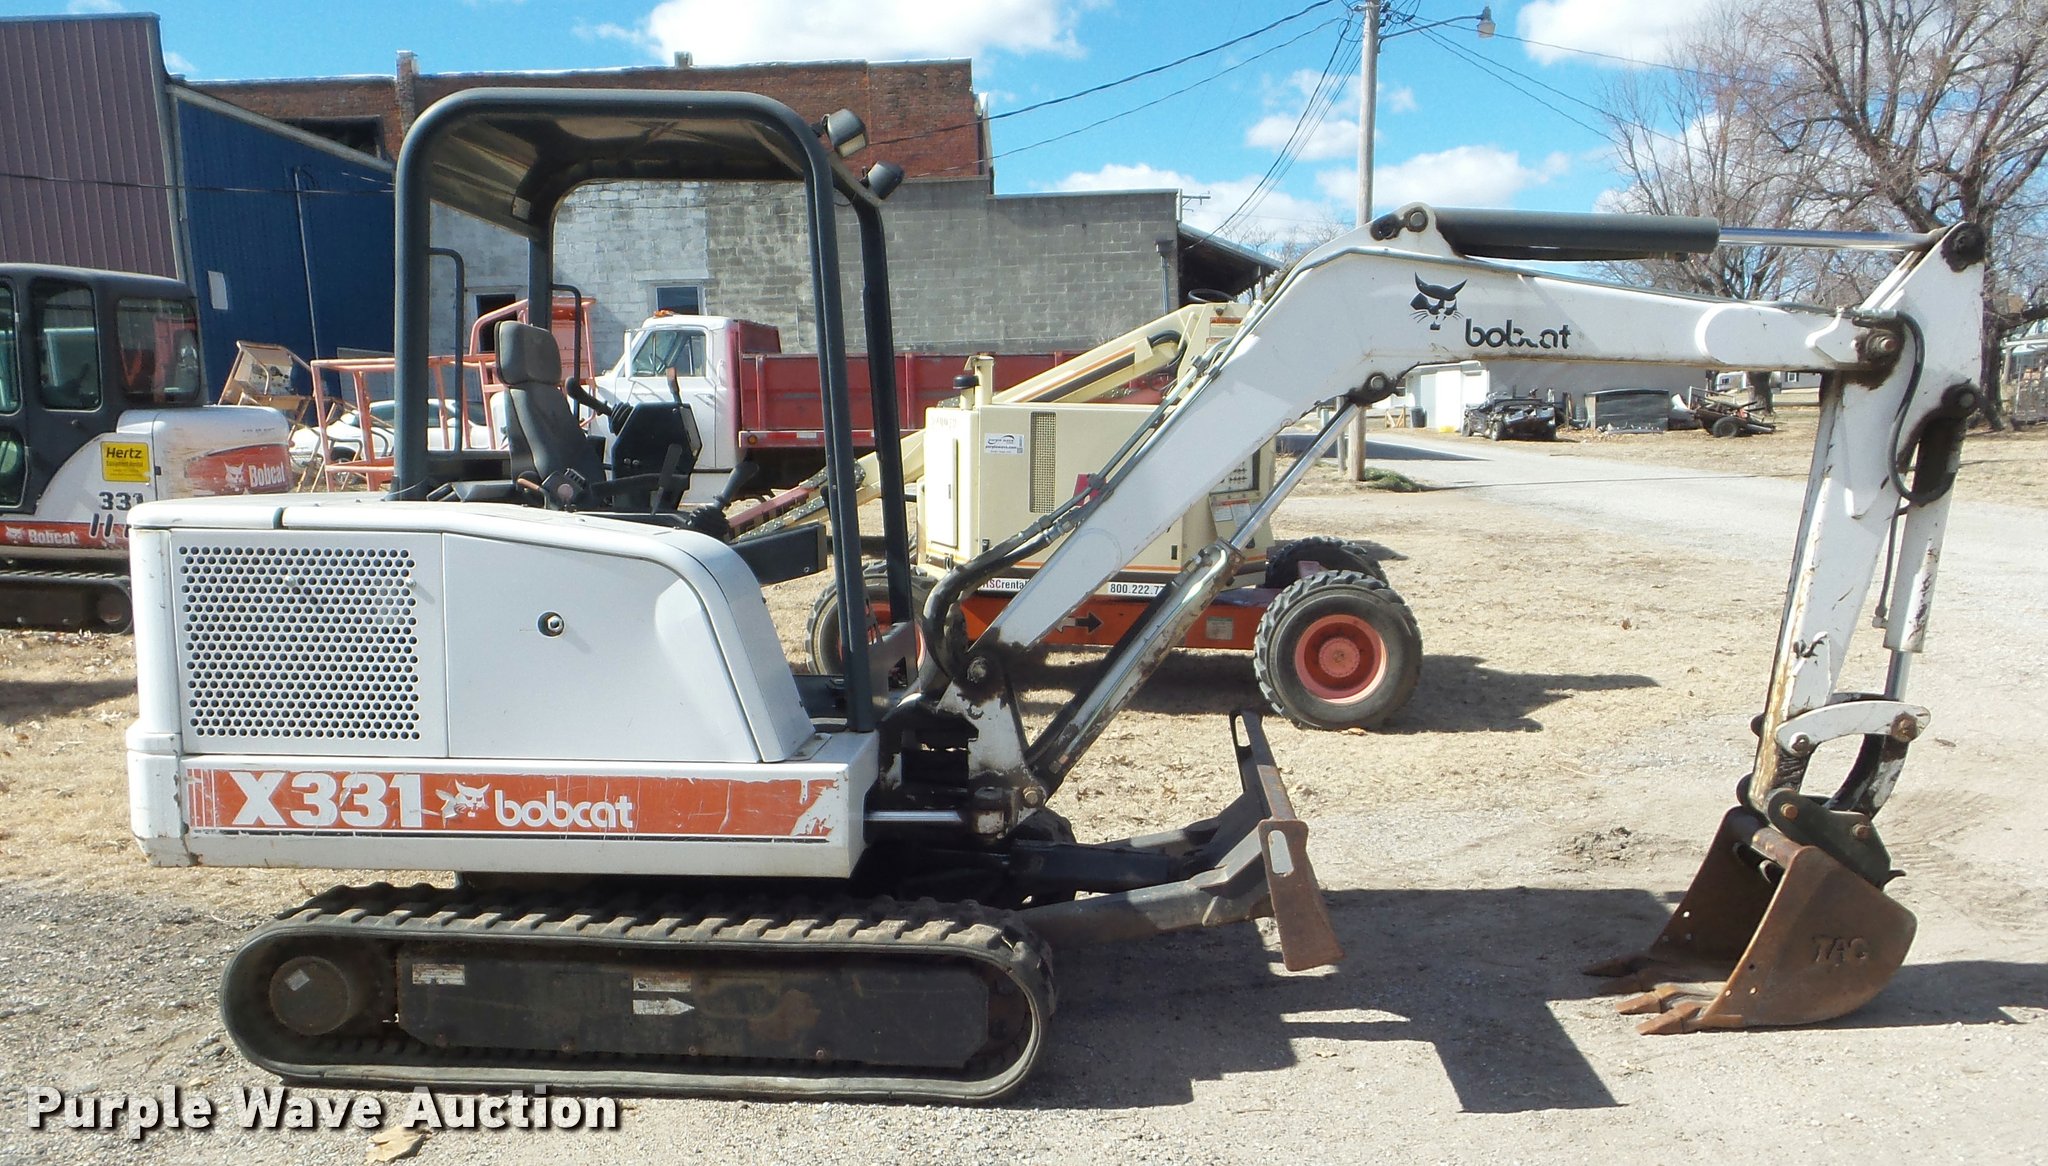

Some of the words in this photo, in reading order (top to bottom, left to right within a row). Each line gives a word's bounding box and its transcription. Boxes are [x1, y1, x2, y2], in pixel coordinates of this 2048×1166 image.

[106, 447, 142, 459] Hertz
[248, 461, 286, 488] Bobcat
[28, 528, 77, 545] Bobcat
[229, 771, 423, 828] X331
[494, 789, 634, 829] bobcat
